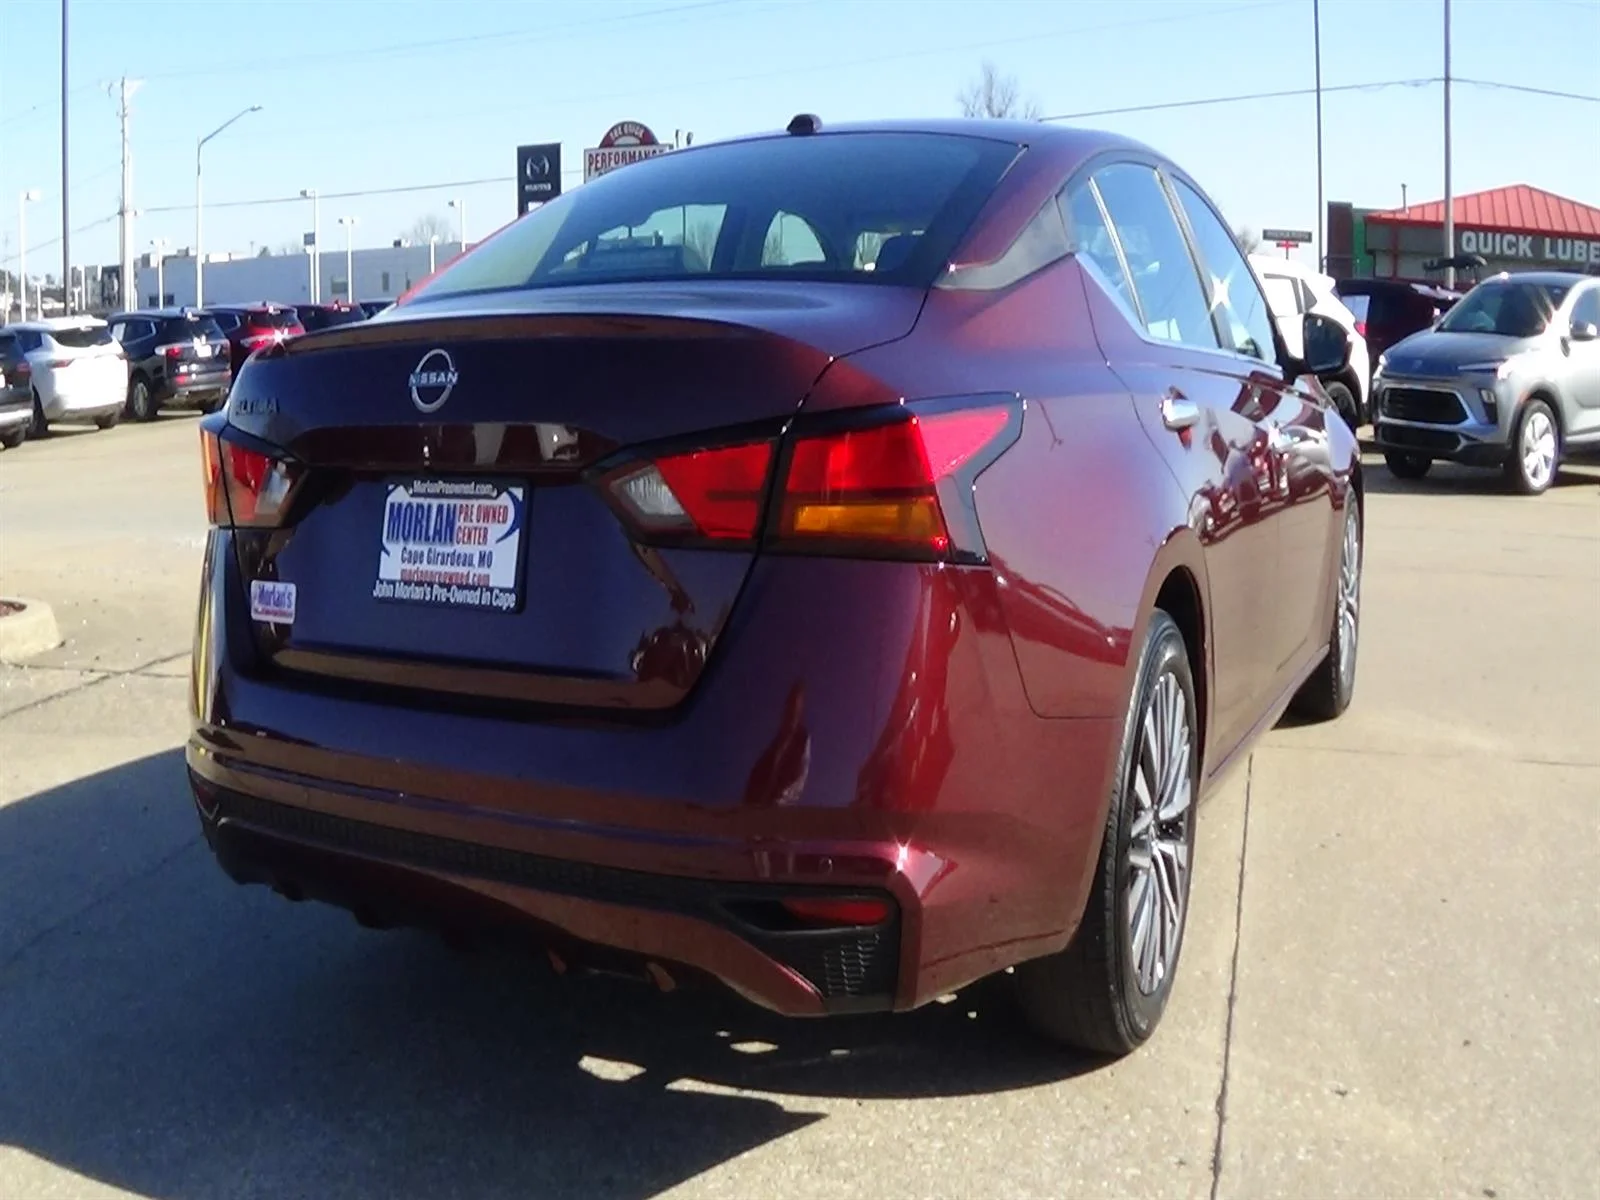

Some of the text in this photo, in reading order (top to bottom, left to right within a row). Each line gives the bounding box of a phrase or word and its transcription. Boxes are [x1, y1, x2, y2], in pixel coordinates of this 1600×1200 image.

[1461, 231, 1533, 257] QUICK
[409, 370, 458, 387] NISSAN
[386, 502, 508, 544] MORLAN PRE OWNED
[456, 527, 488, 545] CENTER
[401, 547, 493, 569] Cape Girardeau, MO
[373, 580, 394, 598] John
[432, 584, 481, 605] Pre-Owned
[482, 587, 491, 606] in
[492, 588, 516, 611] Cape
